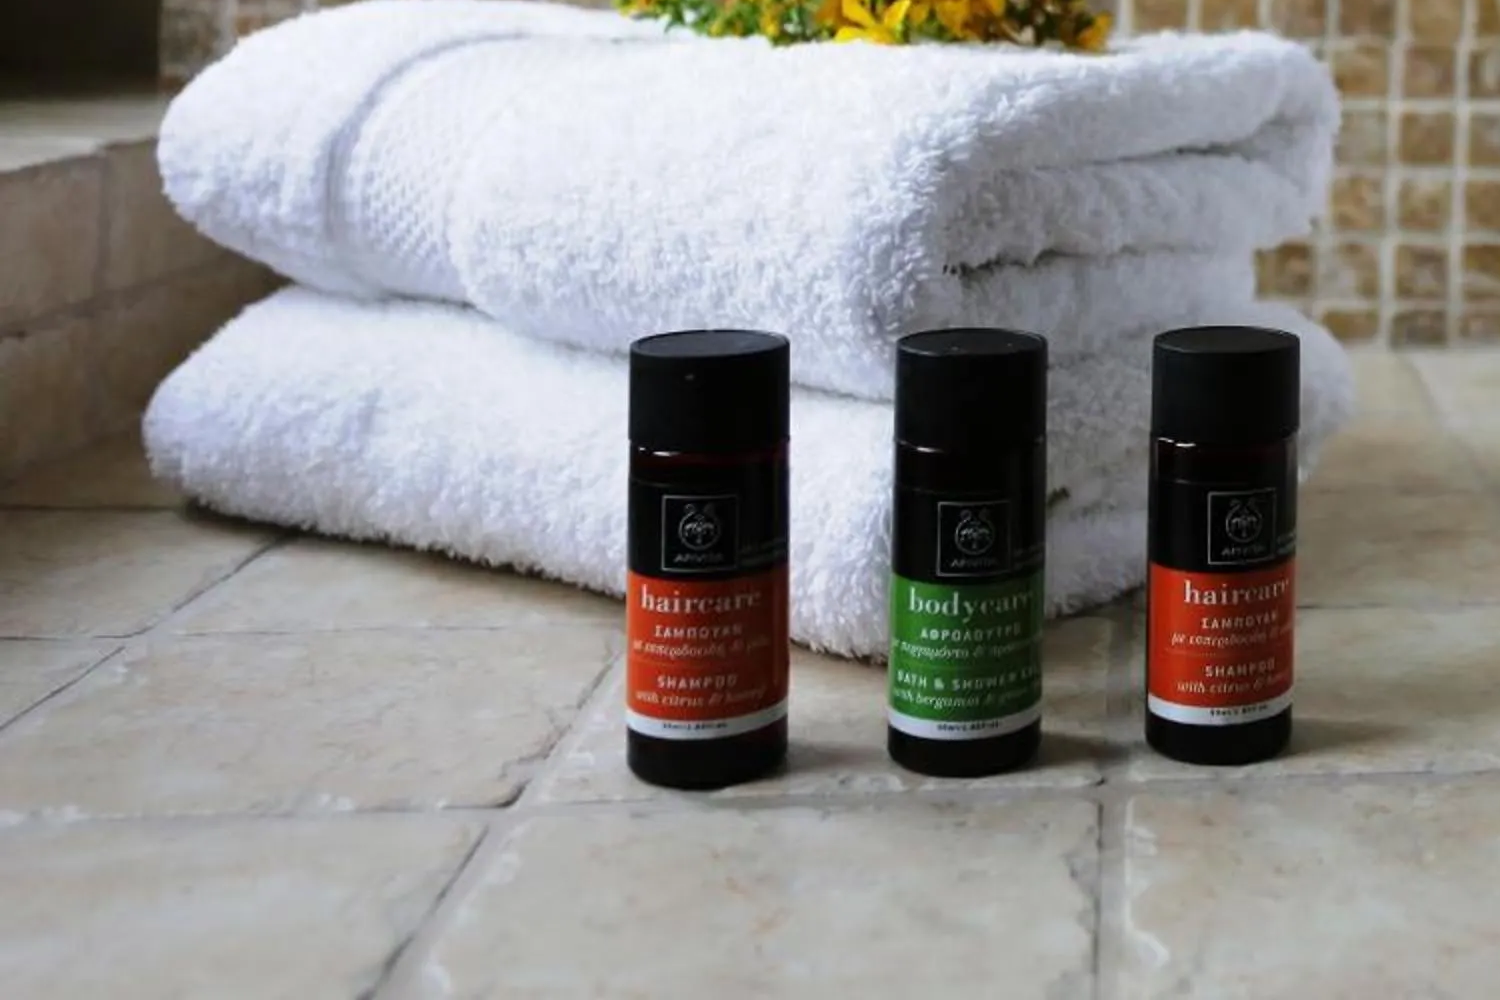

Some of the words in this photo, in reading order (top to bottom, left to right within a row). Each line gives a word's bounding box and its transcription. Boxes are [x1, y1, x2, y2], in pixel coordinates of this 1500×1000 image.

[640, 583, 762, 614] haircare
[1204, 656, 1276, 678] SHAMPOO
[657, 674, 738, 690] SHAMPOO
